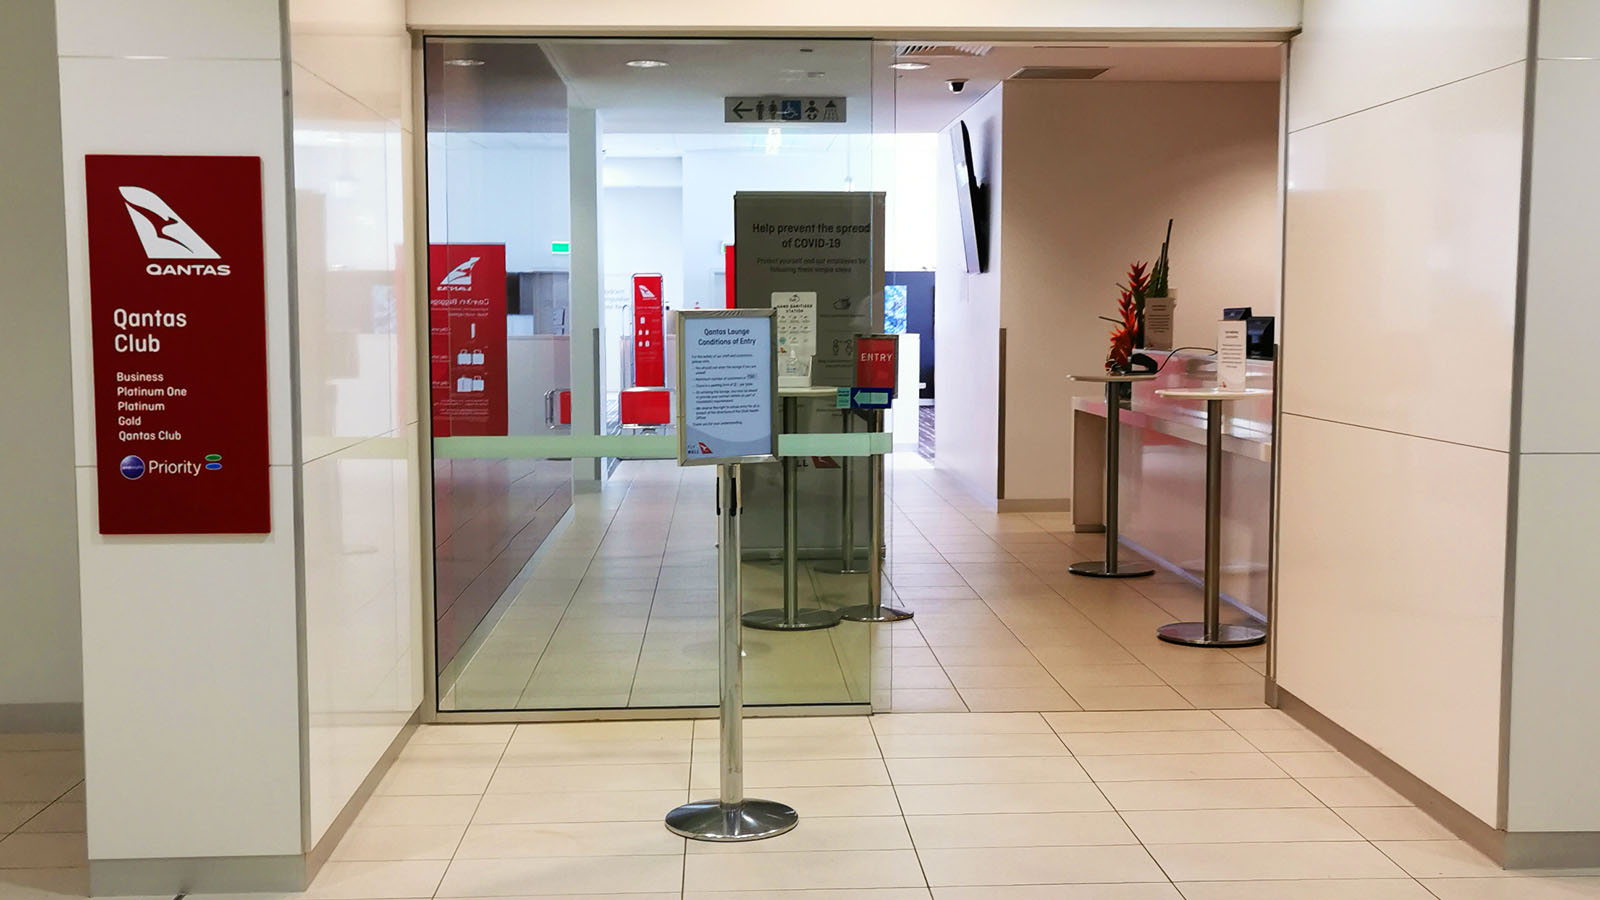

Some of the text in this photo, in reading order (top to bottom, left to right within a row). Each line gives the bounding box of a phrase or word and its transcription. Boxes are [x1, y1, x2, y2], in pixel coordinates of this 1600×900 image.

[752, 223, 871, 235] Help prevent the spread
[782, 238, 841, 248] of COVID-19
[146, 263, 231, 276] QANTAS
[113, 308, 187, 330] Qantas
[703, 328, 750, 336] Qantas Lounge
[114, 333, 160, 352] Club
[698, 338, 731, 346] Conditions
[740, 337, 757, 346] Entry
[861, 353, 893, 362] ENTRY
[116, 371, 165, 382] Business
[117, 386, 188, 397] Platinum One
[117, 400, 165, 411] Platinum
[118, 415, 142, 426] Gold
[118, 430, 182, 442] Qantas Club
[148, 459, 202, 476] Priority
